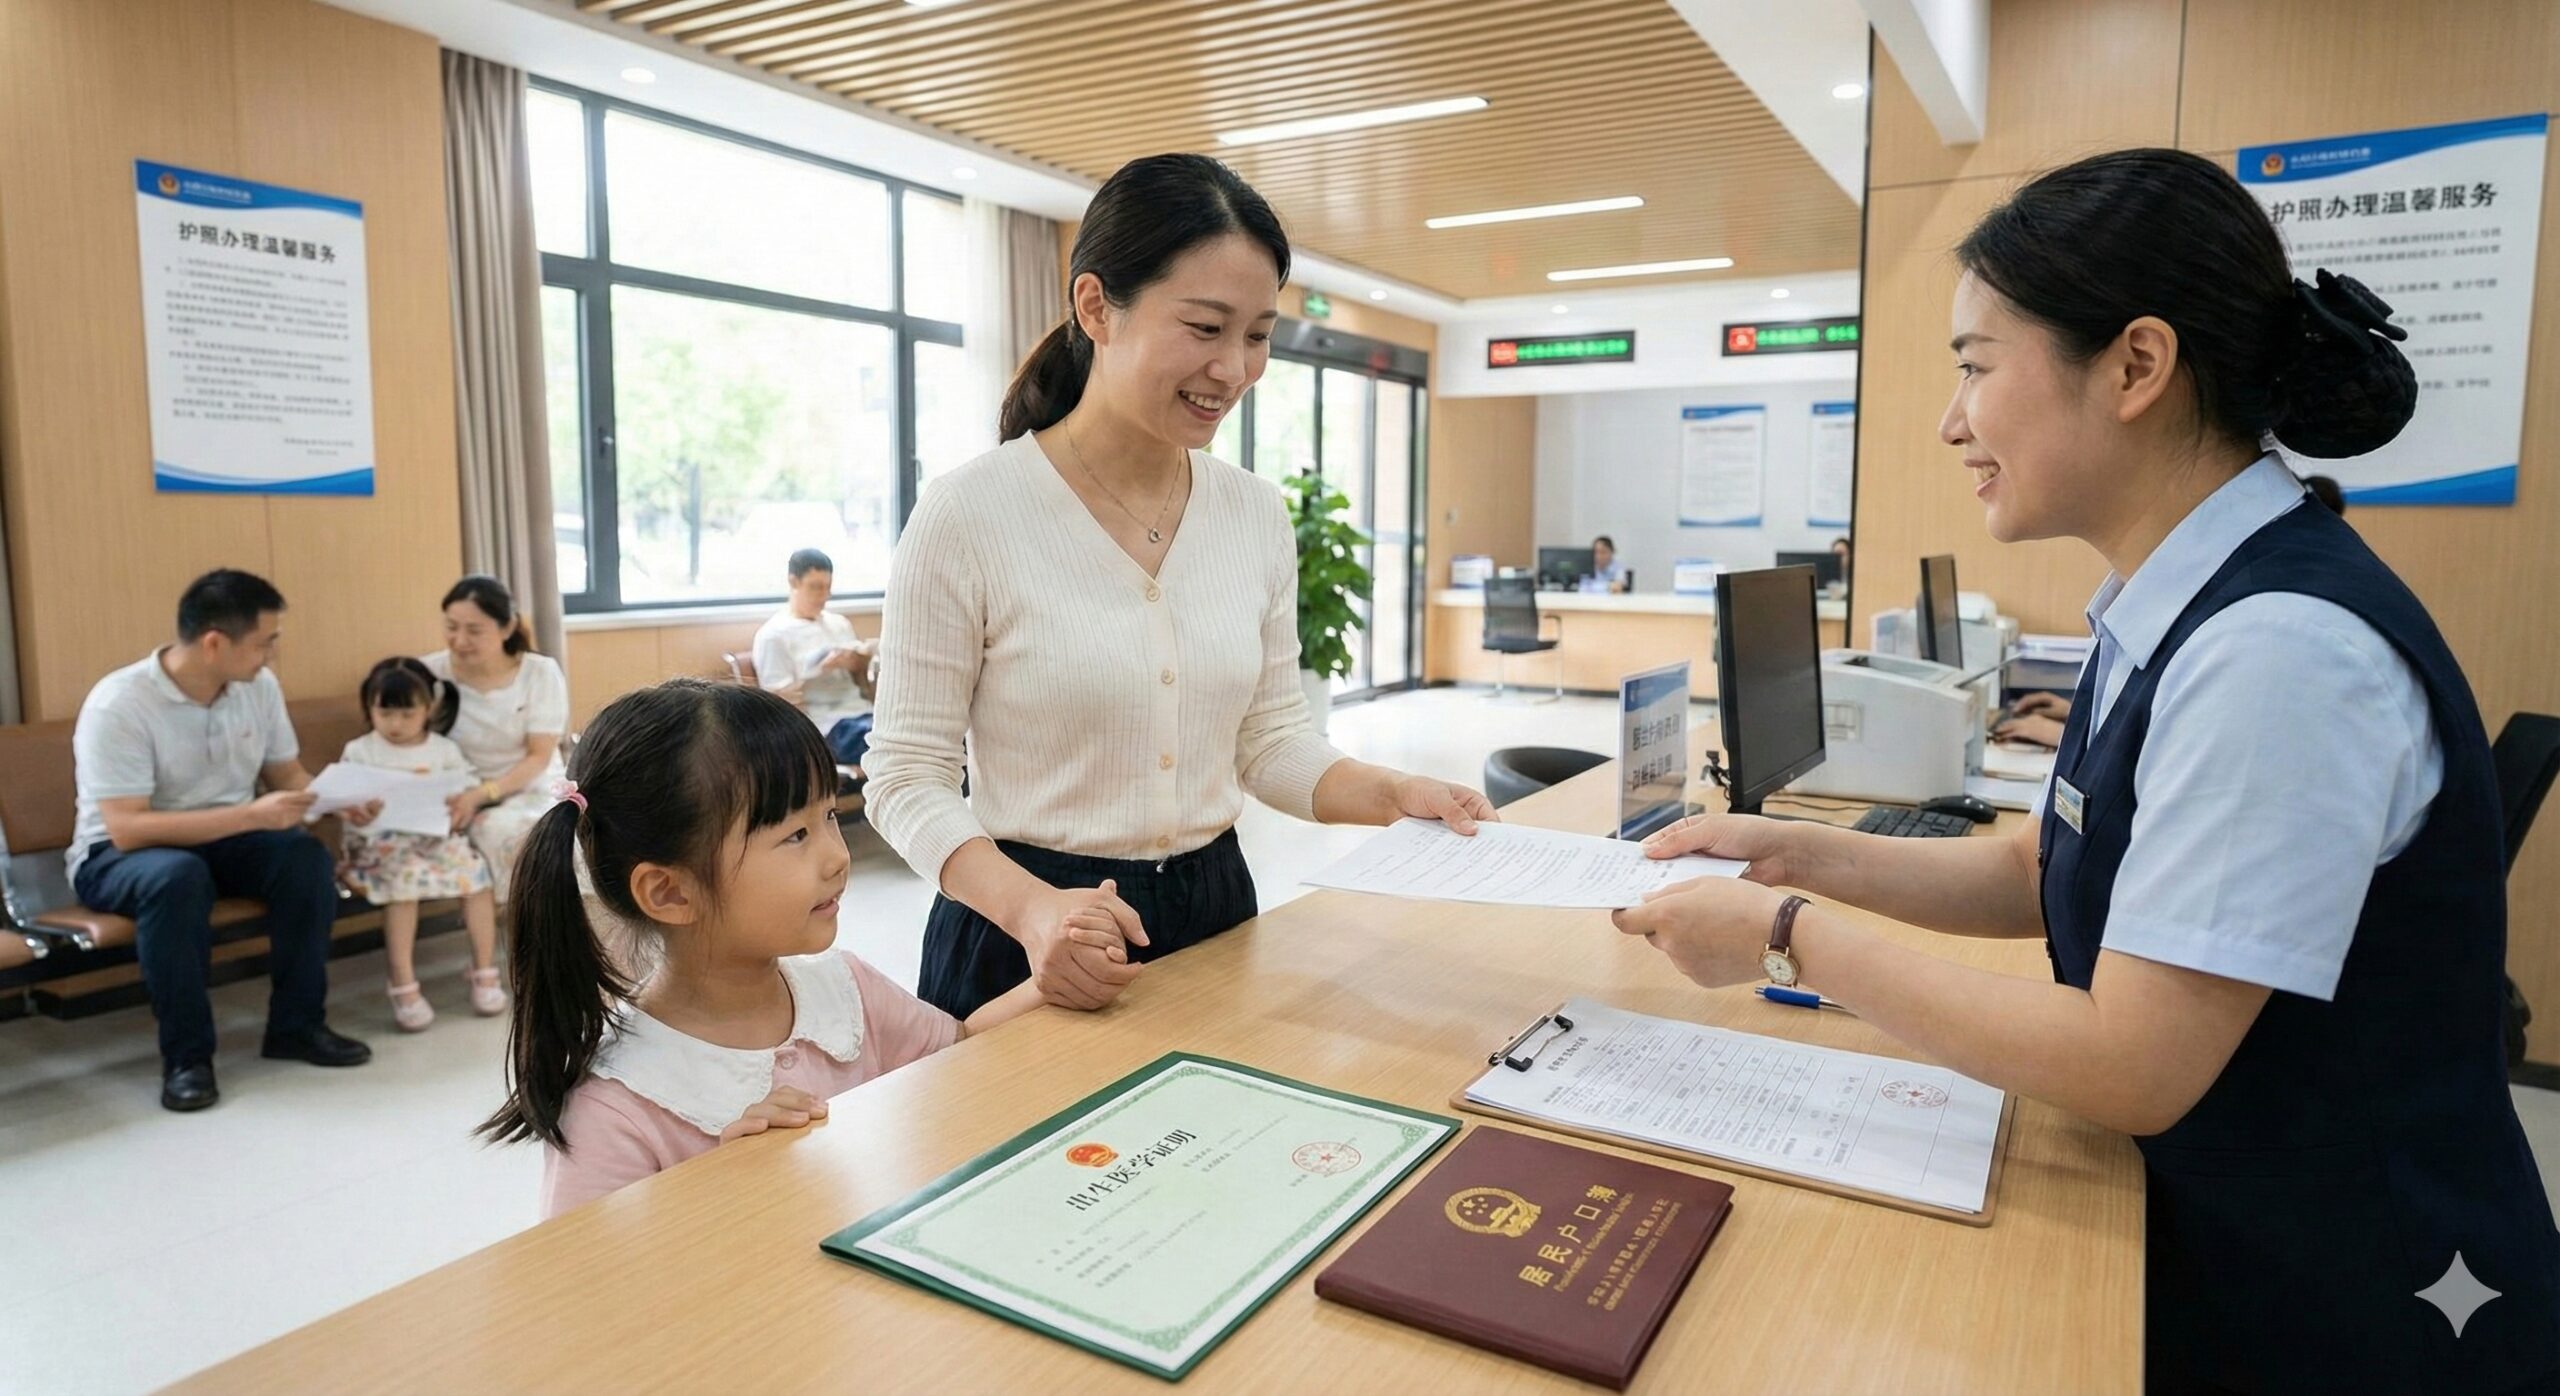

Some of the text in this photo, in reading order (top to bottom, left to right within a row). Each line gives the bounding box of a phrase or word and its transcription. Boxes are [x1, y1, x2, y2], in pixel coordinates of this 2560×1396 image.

[2270, 181, 2499, 225] 护照办理温馨服务
[178, 220, 337, 265] 护照办理温馨服务
[1065, 1128, 1198, 1212] 出生医学证明
